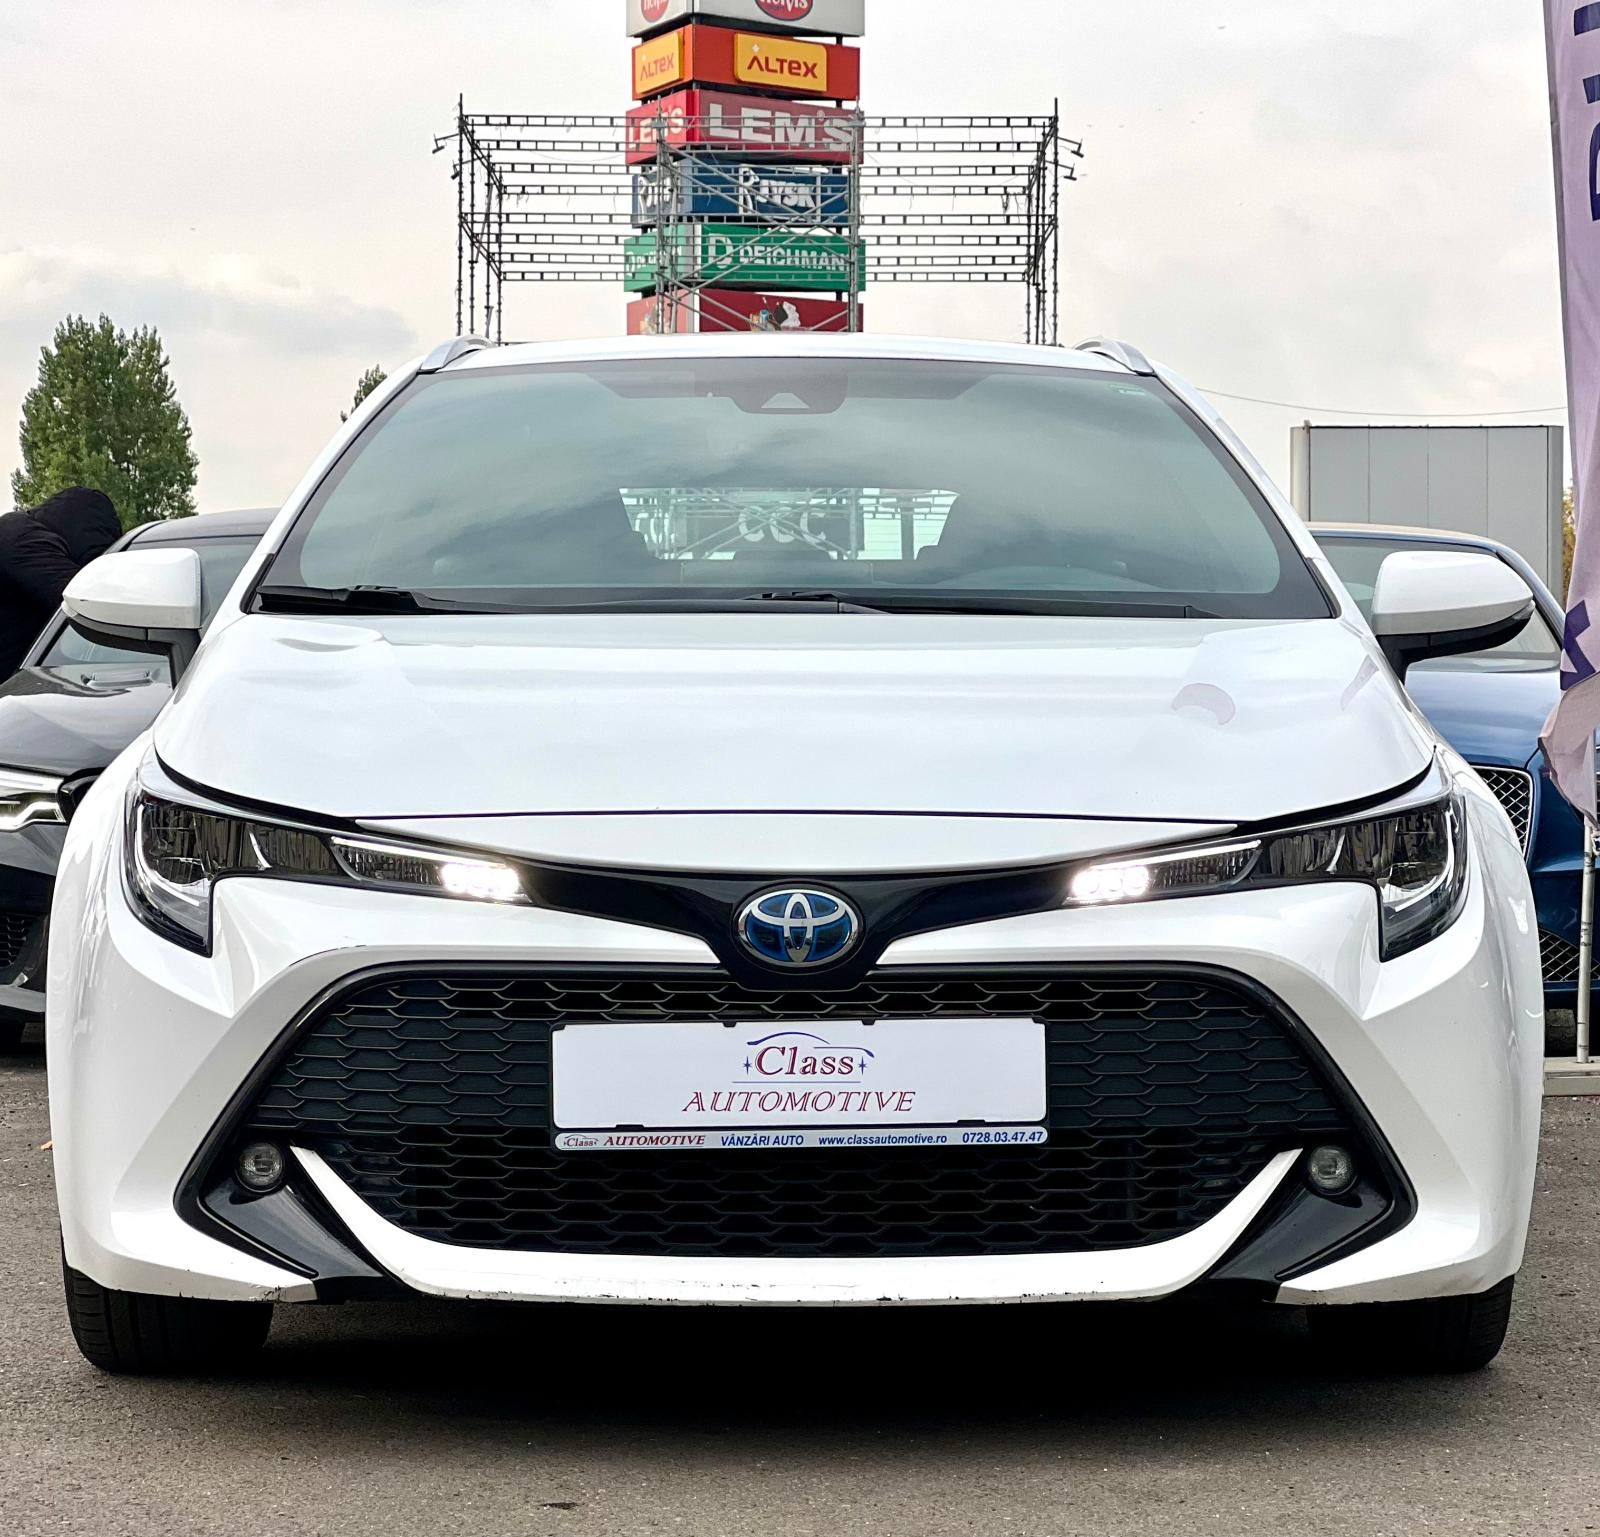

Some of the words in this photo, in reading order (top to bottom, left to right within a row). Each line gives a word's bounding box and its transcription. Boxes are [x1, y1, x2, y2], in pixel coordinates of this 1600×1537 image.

[754, 1046, 855, 1076] Class
[682, 1091, 916, 1112] AUTOMOTIVE
[565, 1137, 595, 1147] Class
[603, 1135, 706, 1147] AUTOMOTIVE
[721, 1133, 771, 1147] VÂNZĂRI
[772, 1134, 804, 1146] AUTO
[818, 1133, 947, 1145] www.classautomotive.ro
[962, 1131, 1044, 1144] 0728.03.47.47
